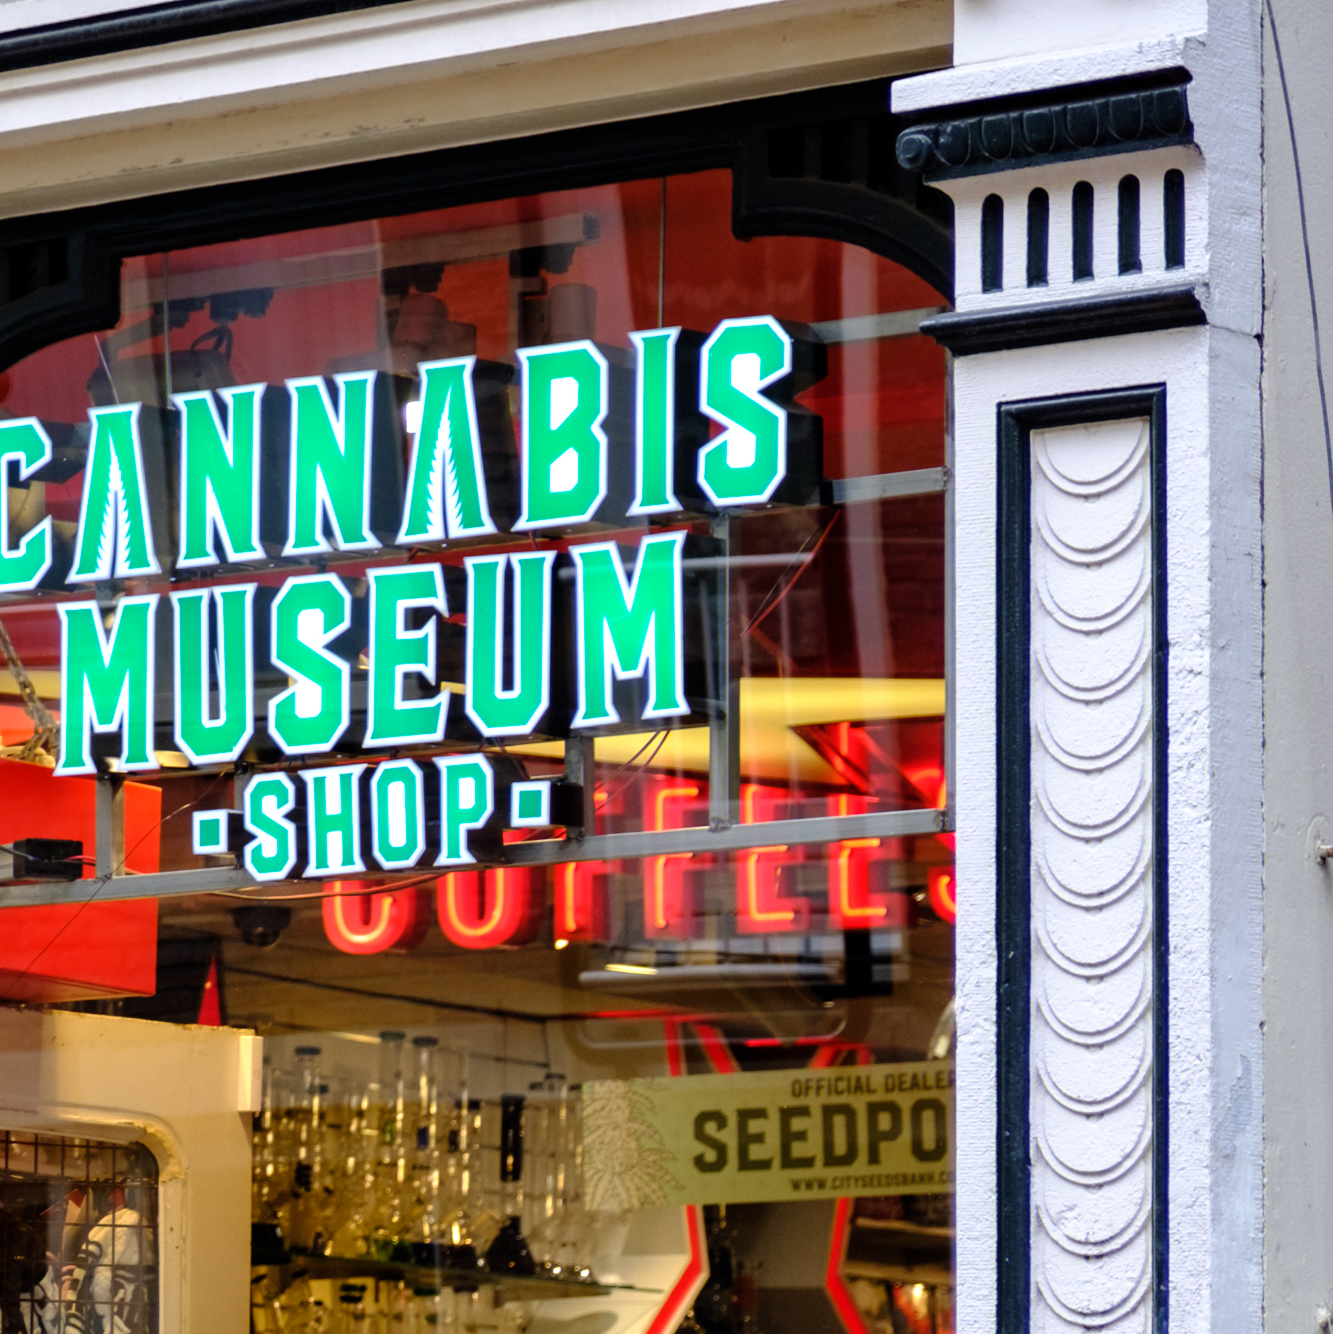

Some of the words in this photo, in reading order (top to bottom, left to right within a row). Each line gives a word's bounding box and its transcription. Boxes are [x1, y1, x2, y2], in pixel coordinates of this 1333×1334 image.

[54, 530, 691, 776] MUSEUM
[244, 751, 497, 882] SHOP
[693, 1097, 947, 1173] SEEDPO
[791, 1074, 877, 1098] OFFICIAL
